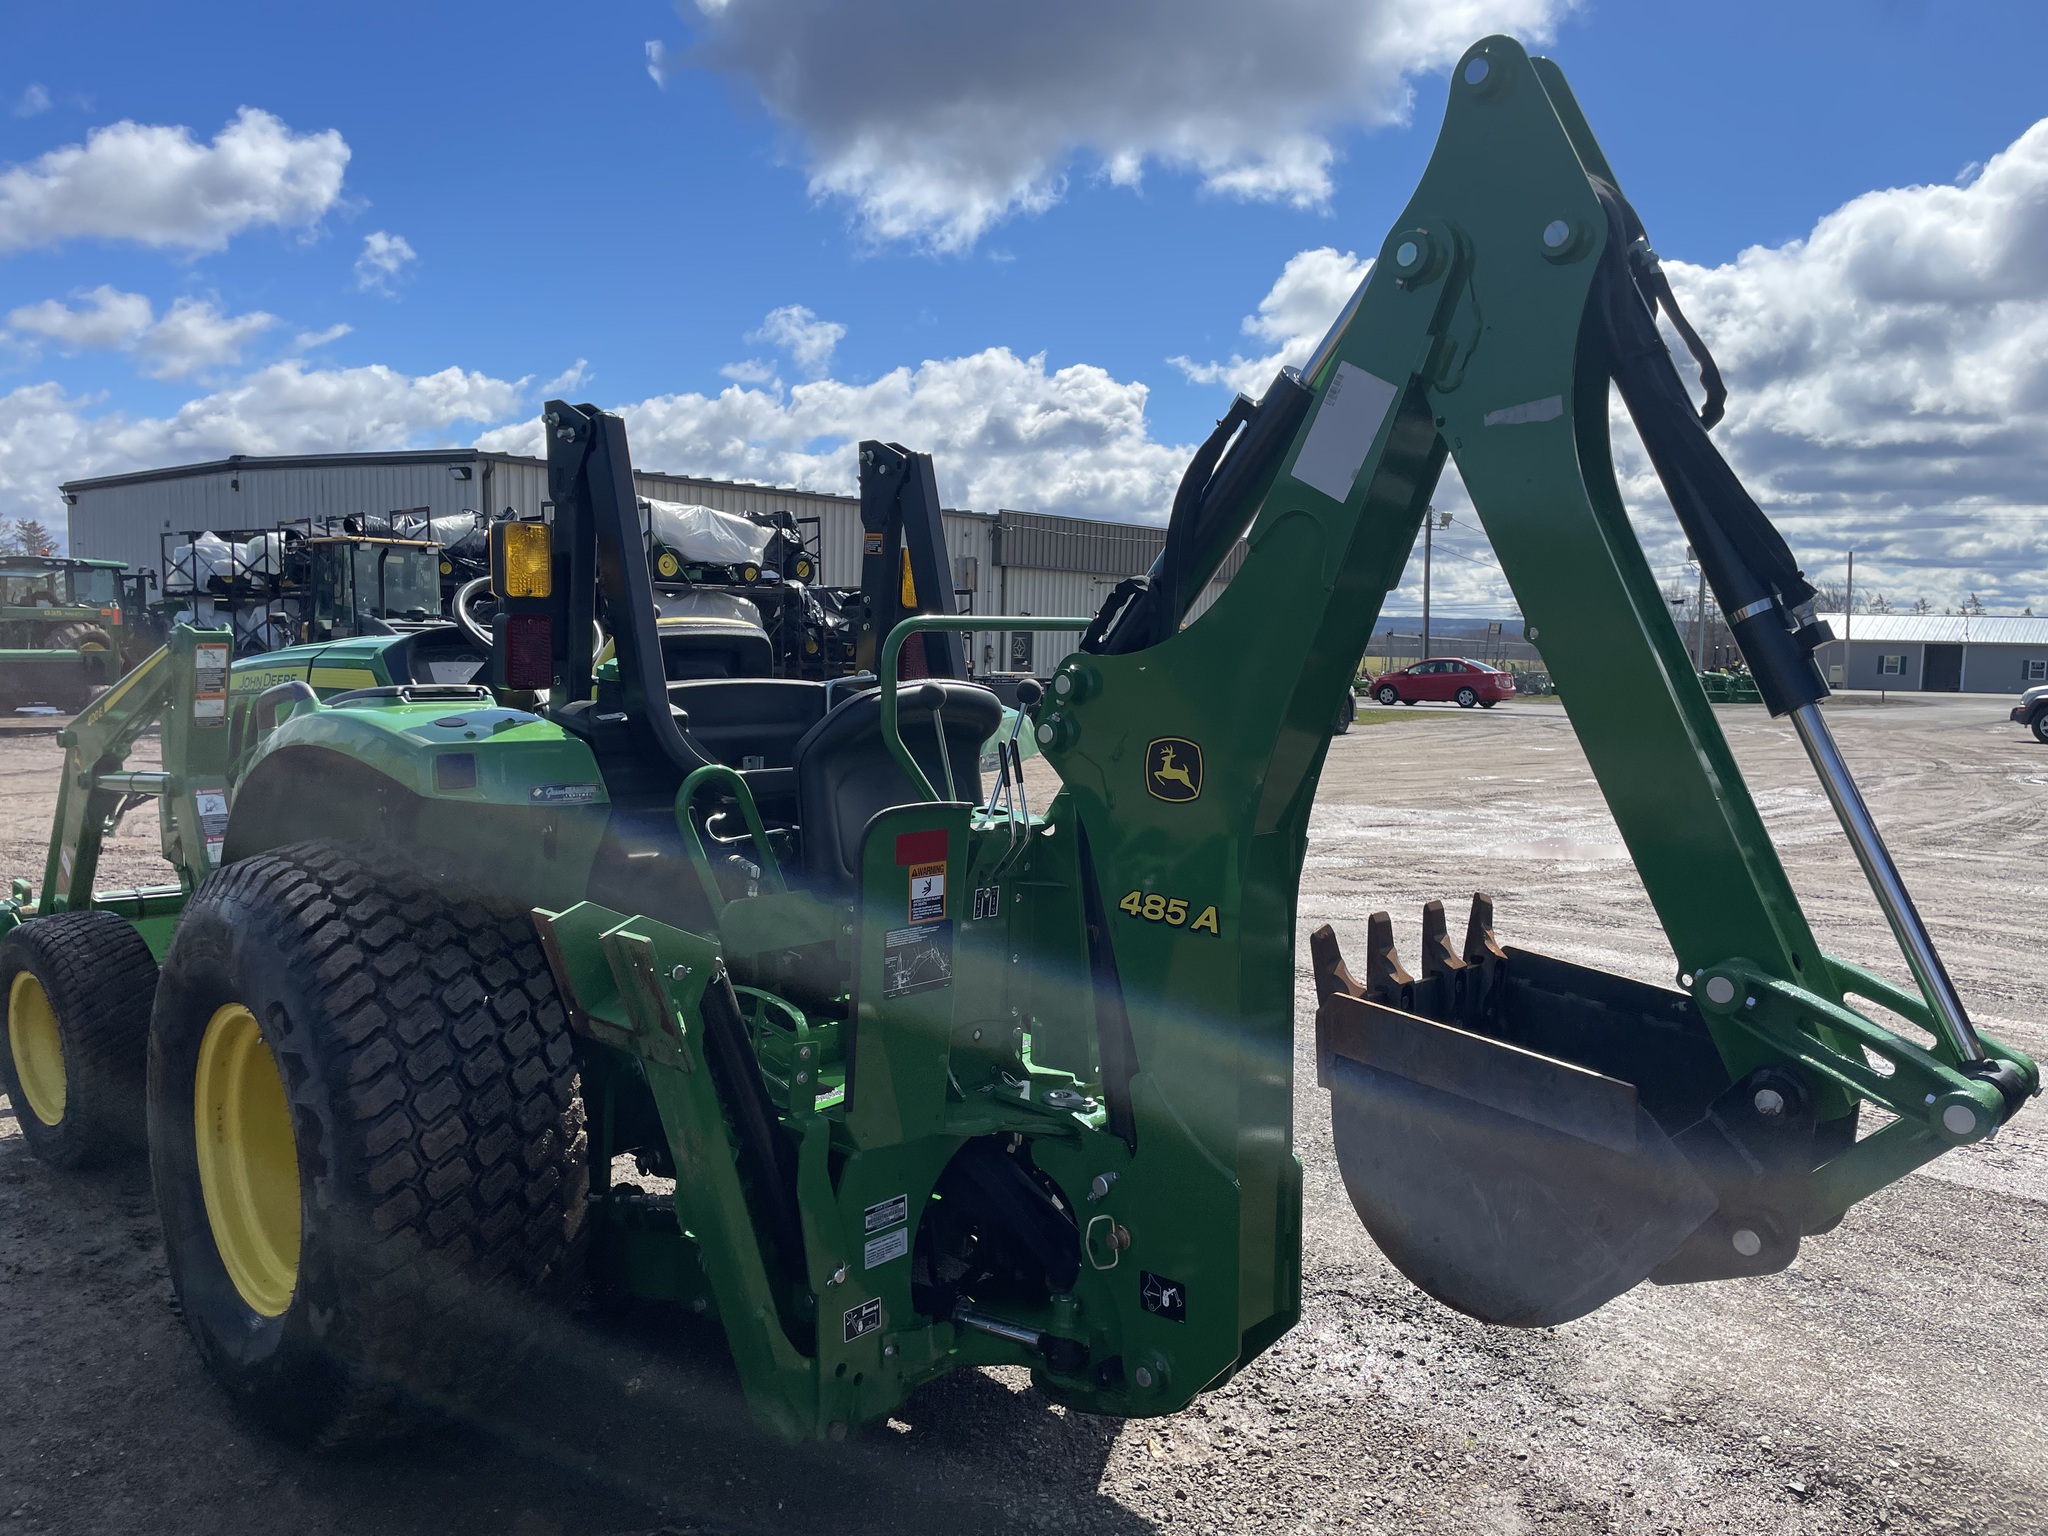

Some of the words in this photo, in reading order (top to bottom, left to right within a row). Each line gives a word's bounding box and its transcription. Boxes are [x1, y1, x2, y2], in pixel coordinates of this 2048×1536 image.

[239, 675, 263, 689] JOHN
[263, 673, 297, 688] DEERE
[917, 864, 944, 876] WARNING
[1119, 890, 1189, 926] 485
